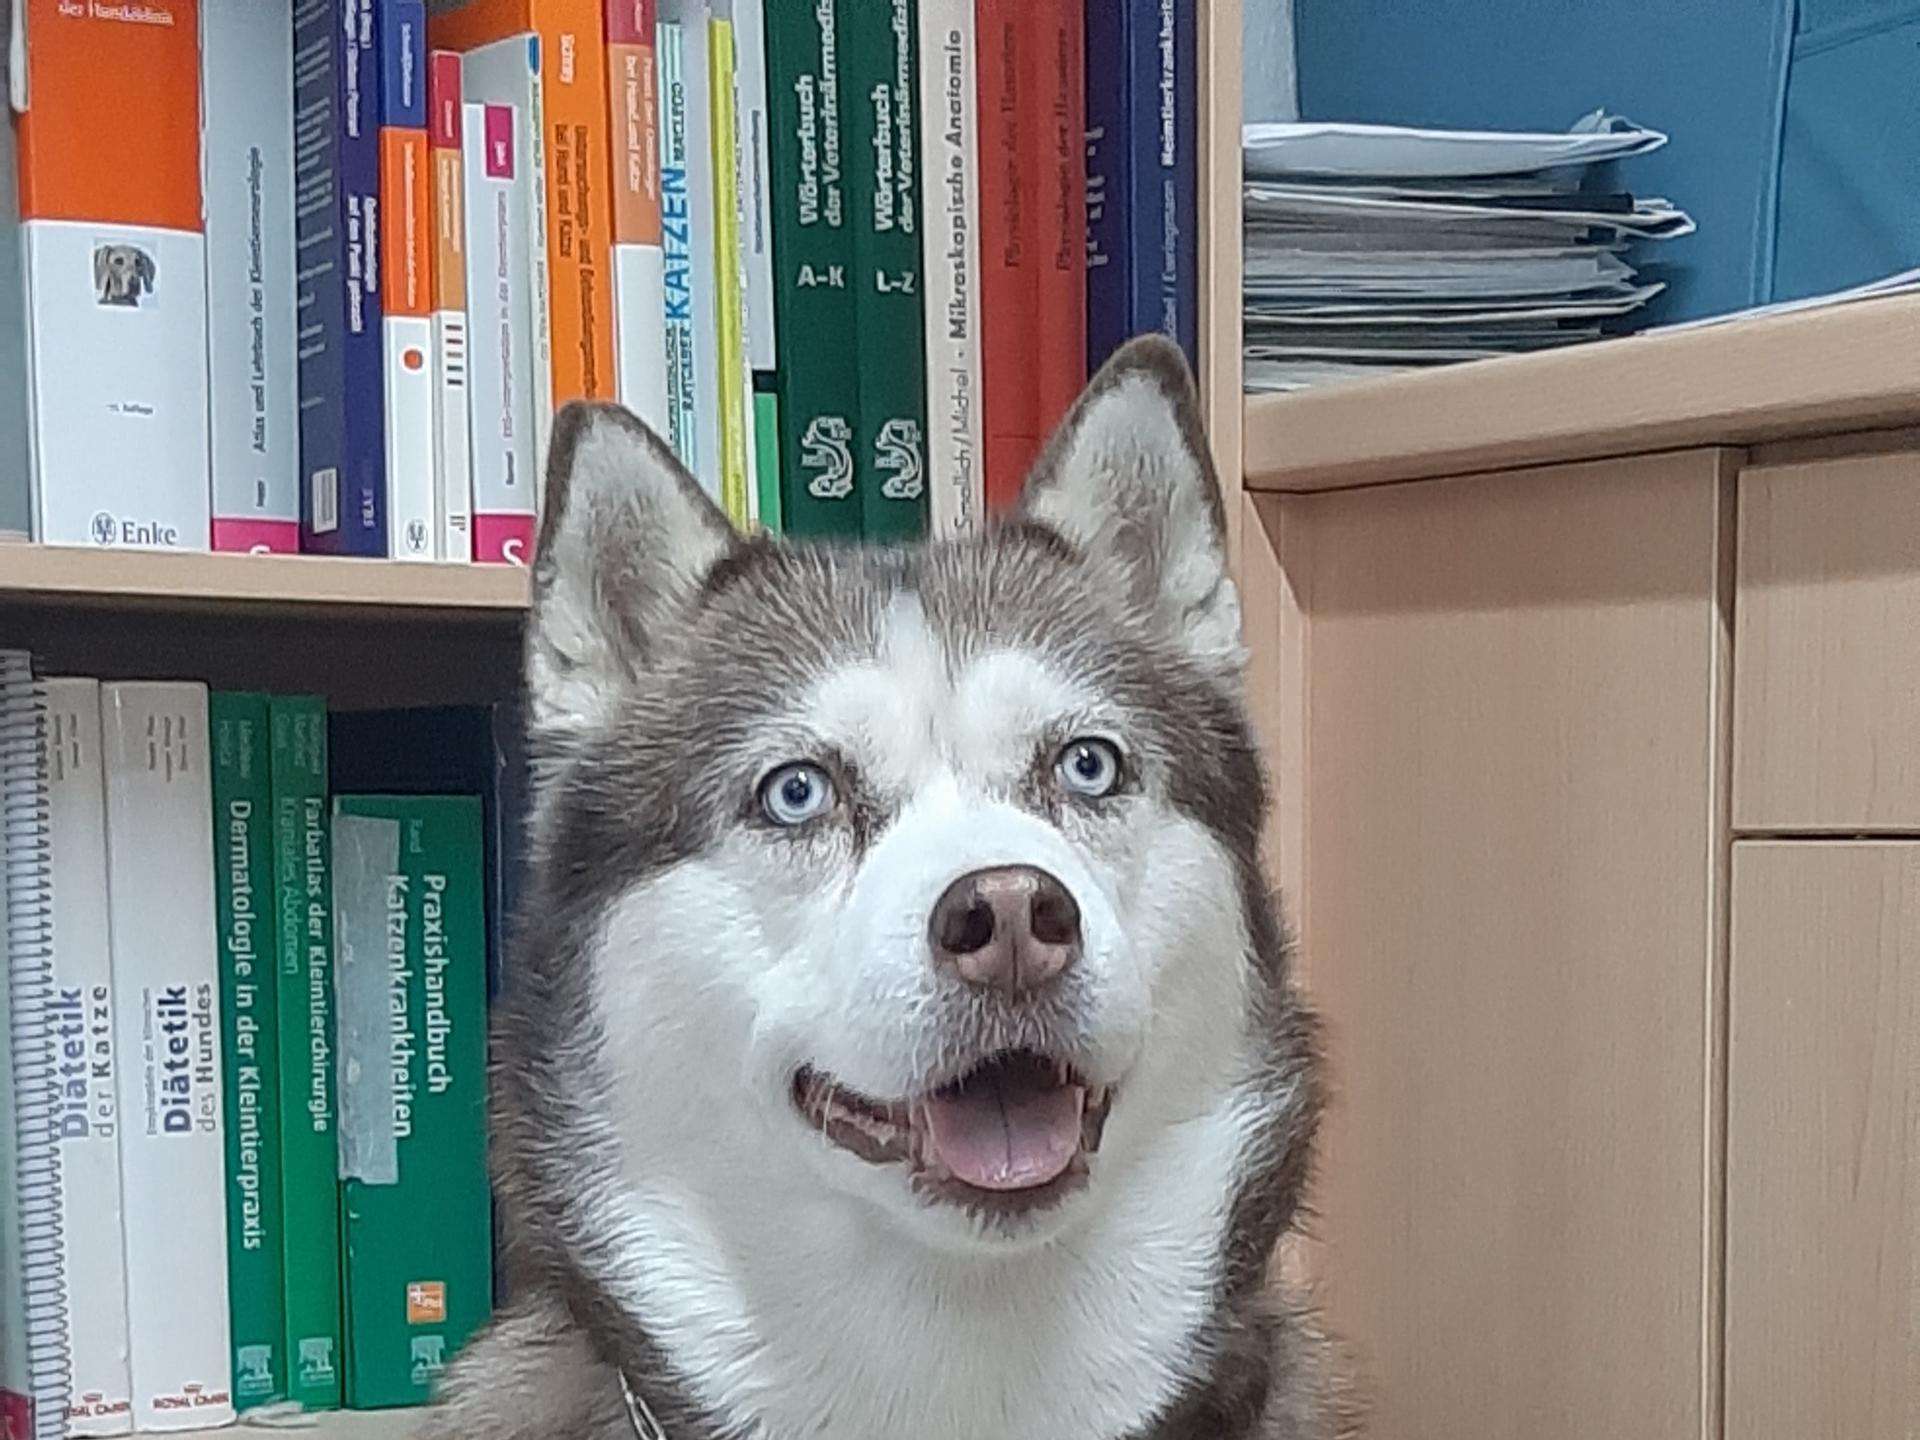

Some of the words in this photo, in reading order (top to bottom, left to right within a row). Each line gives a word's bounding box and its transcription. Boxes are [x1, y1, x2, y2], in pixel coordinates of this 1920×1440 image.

[944, 28, 962, 147] Anatomie
[794, 73, 818, 224] Wörterbuch
[870, 83, 893, 230] Wörterbuch
[661, 166, 690, 320] KATZEN
[824, 185, 841, 226] der
[902, 193, 914, 233] der
[946, 154, 967, 338] Mikroskopische
[122, 520, 178, 546] Enke
[228, 801, 258, 976] Dermatologie
[304, 799, 324, 896] Farbatlas
[281, 886, 301, 974] Abdomen
[307, 903, 325, 938] der
[91, 985, 111, 1077] Katze
[192, 982, 213, 1082] Hundes
[235, 985, 257, 1008] in
[235, 1016, 258, 1058] der
[385, 874, 416, 1137] Katzenkrankheiten
[421, 874, 452, 1093] Praxishandbuch
[49, 988, 89, 1136] Diätetik
[157, 985, 192, 1131] Diätetik
[307, 947, 331, 1131] Kleintierchirurgie
[92, 1091, 115, 1136] der
[196, 1092, 216, 1131] des
[235, 1066, 266, 1249] Kleintierpraxis
